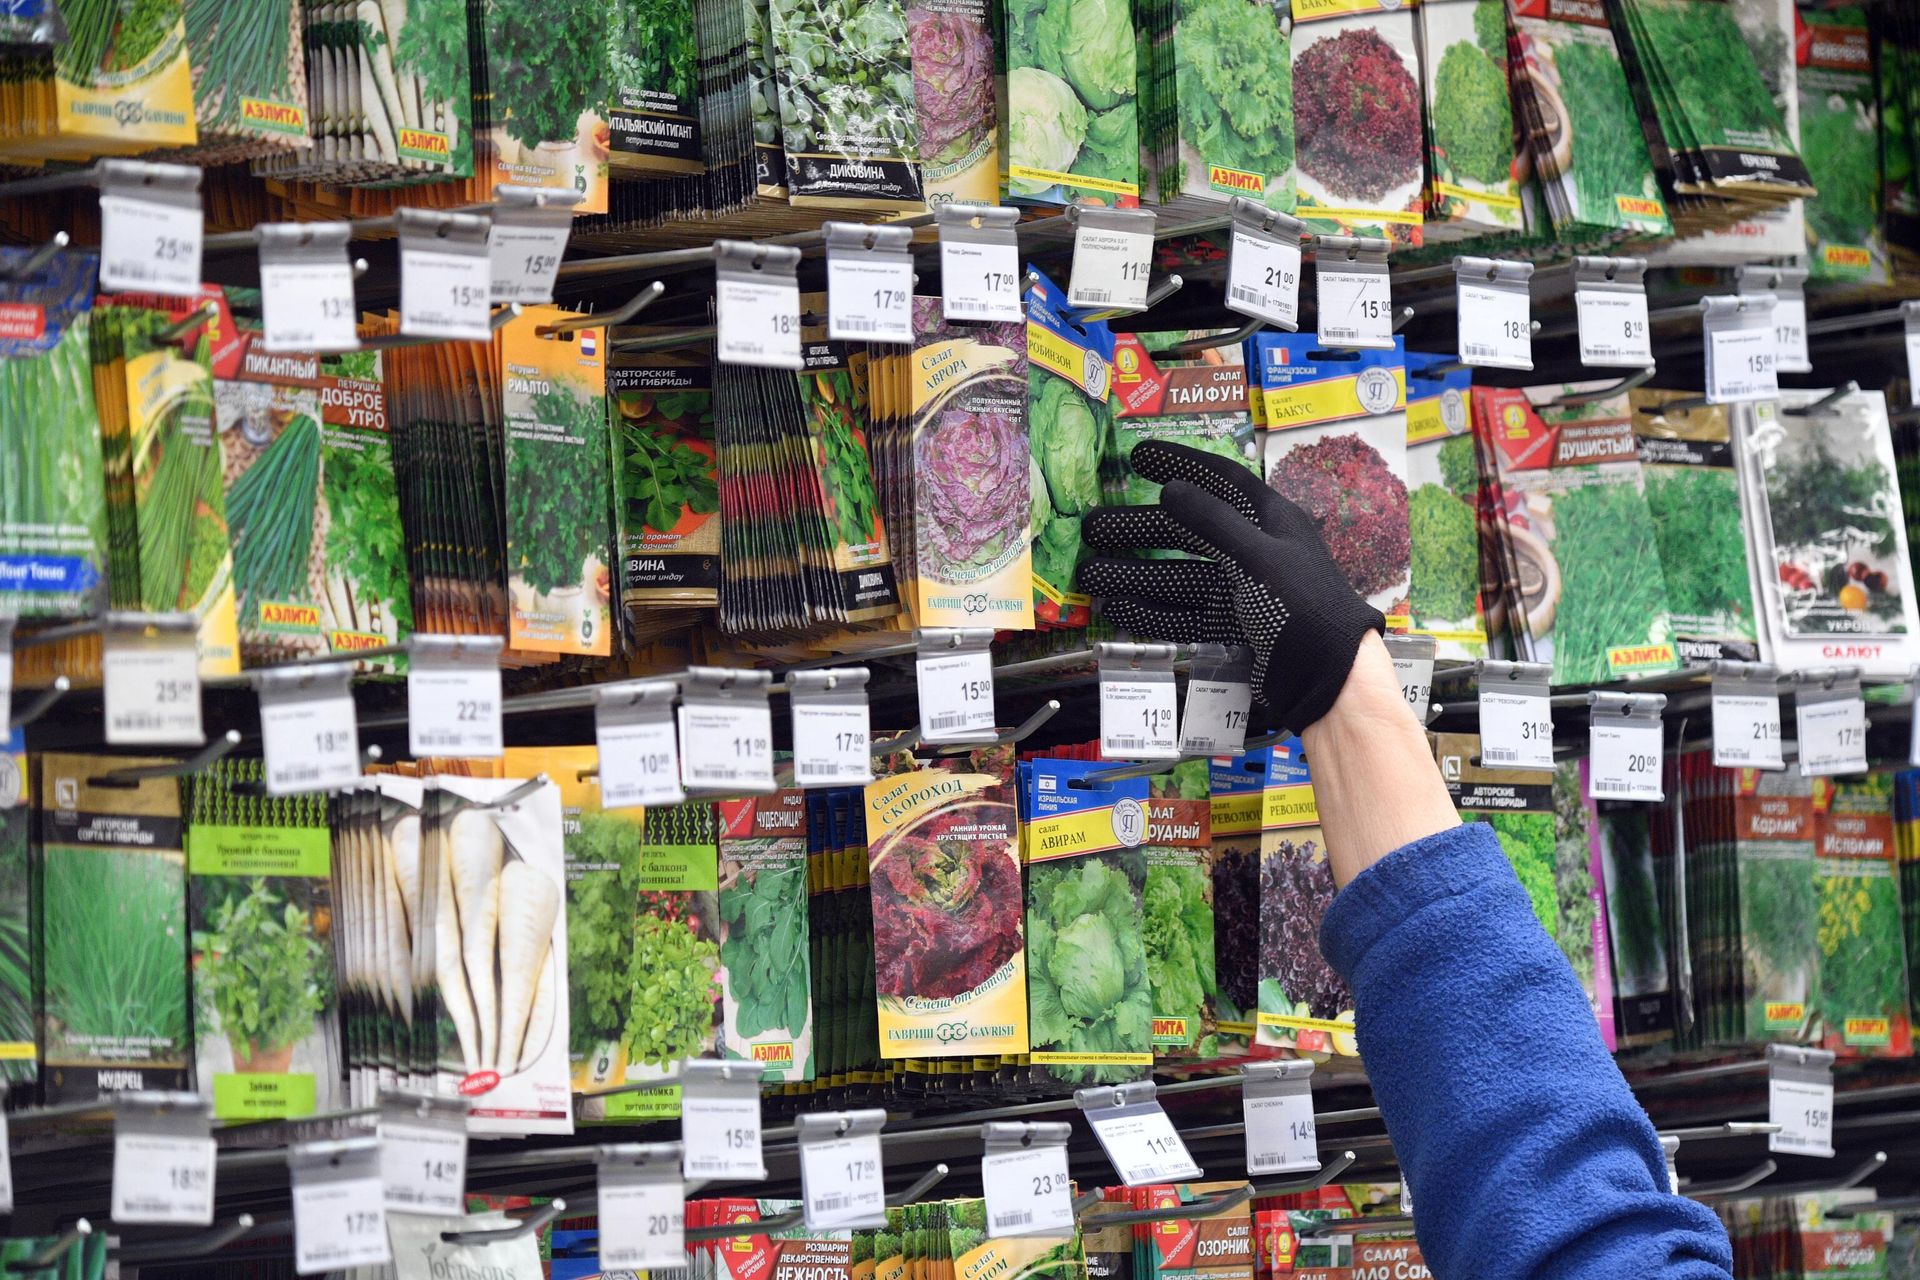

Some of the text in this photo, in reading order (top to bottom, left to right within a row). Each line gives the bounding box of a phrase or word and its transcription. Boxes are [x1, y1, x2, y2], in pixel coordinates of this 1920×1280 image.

[245, 102, 302, 127] АЭЛИТА
[608, 117, 693, 141] ИТАЛЬЯНСКИЙ ГИГАНТ
[401, 133, 447, 152] АЭЛИТА
[956, 138, 991, 172] автора
[829, 163, 886, 180] ДИКОВИНА
[1213, 168, 1262, 192] АЭЛИТА
[155, 237, 178, 260] 25
[525, 255, 544, 275] 15
[1121, 261, 1138, 281] 11
[984, 272, 1014, 292] 17 00
[1265, 266, 1294, 288] 21 00
[451, 285, 471, 308] 15
[873, 289, 906, 310] 17 00
[1361, 300, 1392, 319] 15 00
[771, 314, 789, 335] 18
[1503, 320, 1519, 339] 18
[1624, 321, 1643, 339] 8 10
[1776, 326, 1790, 344] 17
[921, 347, 953, 371] Салат
[1028, 341, 1072, 370] РОБИНЗОН
[1748, 355, 1763, 373] 15
[245, 355, 318, 380] ПИКАНТНЫЙ
[615, 370, 677, 378] АВТОРСКИЕ
[925, 359, 968, 392] АВРОРА
[1213, 371, 1241, 382] САЛАТ
[1266, 366, 1318, 375] ФРАНЦУЗСКАЯ
[337, 379, 381, 393] ПЕТРУШКА
[508, 378, 550, 396] РИАЛТО
[640, 378, 692, 387] ГИБРИДЫ
[1267, 374, 1293, 383] ЛИНИЯ
[321, 387, 383, 411] ДОБРОЕ
[1131, 383, 1161, 410] РЕГИОНОВ
[1169, 384, 1244, 405] ТАЙФУН
[348, 408, 385, 430] УТРО
[1275, 402, 1314, 419] БАКУС
[1559, 434, 1635, 462] ДУШИСТЫЙ
[646, 533, 682, 542] аромат
[940, 537, 1024, 581] Семена от автора
[658, 572, 684, 583] индау
[928, 596, 1025, 612] ГАВРИШ GAVRISH
[264, 604, 317, 624] АЭЛИТА
[1613, 646, 1671, 665] АЭЛИТА
[1822, 645, 1883, 659] САЛЮТ
[961, 680, 991, 702] 15 00
[1402, 684, 1431, 704] 15 00
[457, 701, 477, 722] 22
[1142, 708, 1171, 728] 11 00
[1225, 710, 1241, 729] 17
[1522, 721, 1550, 740] 31 00
[1753, 722, 1780, 740] 21 00
[1838, 728, 1853, 746] 17
[733, 737, 767, 758] 11 00
[836, 732, 864, 752] 17 00
[641, 754, 658, 775] 10
[1628, 754, 1657, 773] 20 00
[1271, 771, 1288, 781] ЛИНИЯ
[783, 796, 803, 806] ИНДАУ
[871, 782, 909, 811] Салат
[882, 778, 964, 824] СКОРОХОД
[1037, 794, 1078, 804] ИЗРАИЛЬСКАЯ
[1473, 786, 1515, 797] АВТОРСКИЕ
[1038, 803, 1058, 811] ЛИНИЯ
[1461, 797, 1484, 806] СОРТА
[1492, 797, 1527, 808] ГИБРИДЫ
[936, 832, 1008, 842] ХРУСТЯЩИХ ЛИСТЬЕВ
[949, 823, 1007, 832] РАННИЙ УРОЖАЙ
[1038, 824, 1060, 834] салат
[1041, 831, 1087, 850] АВИРАМ
[1823, 833, 1884, 855] Исполин
[648, 862, 688, 873] балкона
[904, 962, 1015, 1009] Семена от автора
[888, 1026, 1015, 1040] ГАВРИШ GAVRISH
[752, 1044, 792, 1061] АЭЛИТА
[97, 1070, 144, 1091] МУДРЕЦ
[1804, 1109, 1819, 1128] 15
[725, 1129, 755, 1149] 15 00
[1290, 1121, 1307, 1141] 14
[1147, 1136, 1177, 1155] 11 00
[423, 1159, 443, 1180] 14
[846, 1161, 875, 1181] 17 00
[1032, 1173, 1067, 1197] 23 00
[728, 1204, 757, 1213] УДАЧНЫЙ
[647, 1215, 669, 1235] 20
[1227, 1226, 1249, 1237] САЛАТ
[805, 1243, 849, 1253] РОЗМАРИН
[1166, 1228, 1194, 1263] СКОРОСПЕЛЫЙ
[1198, 1239, 1250, 1258] ОЗОРНИК
[736, 1247, 766, 1274] СИЛЬНЫЙ
[779, 1253, 849, 1265] ЛЕКАРСТВЕННЫЙ
[964, 1249, 996, 1279] Салат
[1362, 1248, 1409, 1264] САЛАТ
[744, 1258, 767, 1280] АРОМАТ
[776, 1266, 849, 1280] НЕЖНОСТЬ
